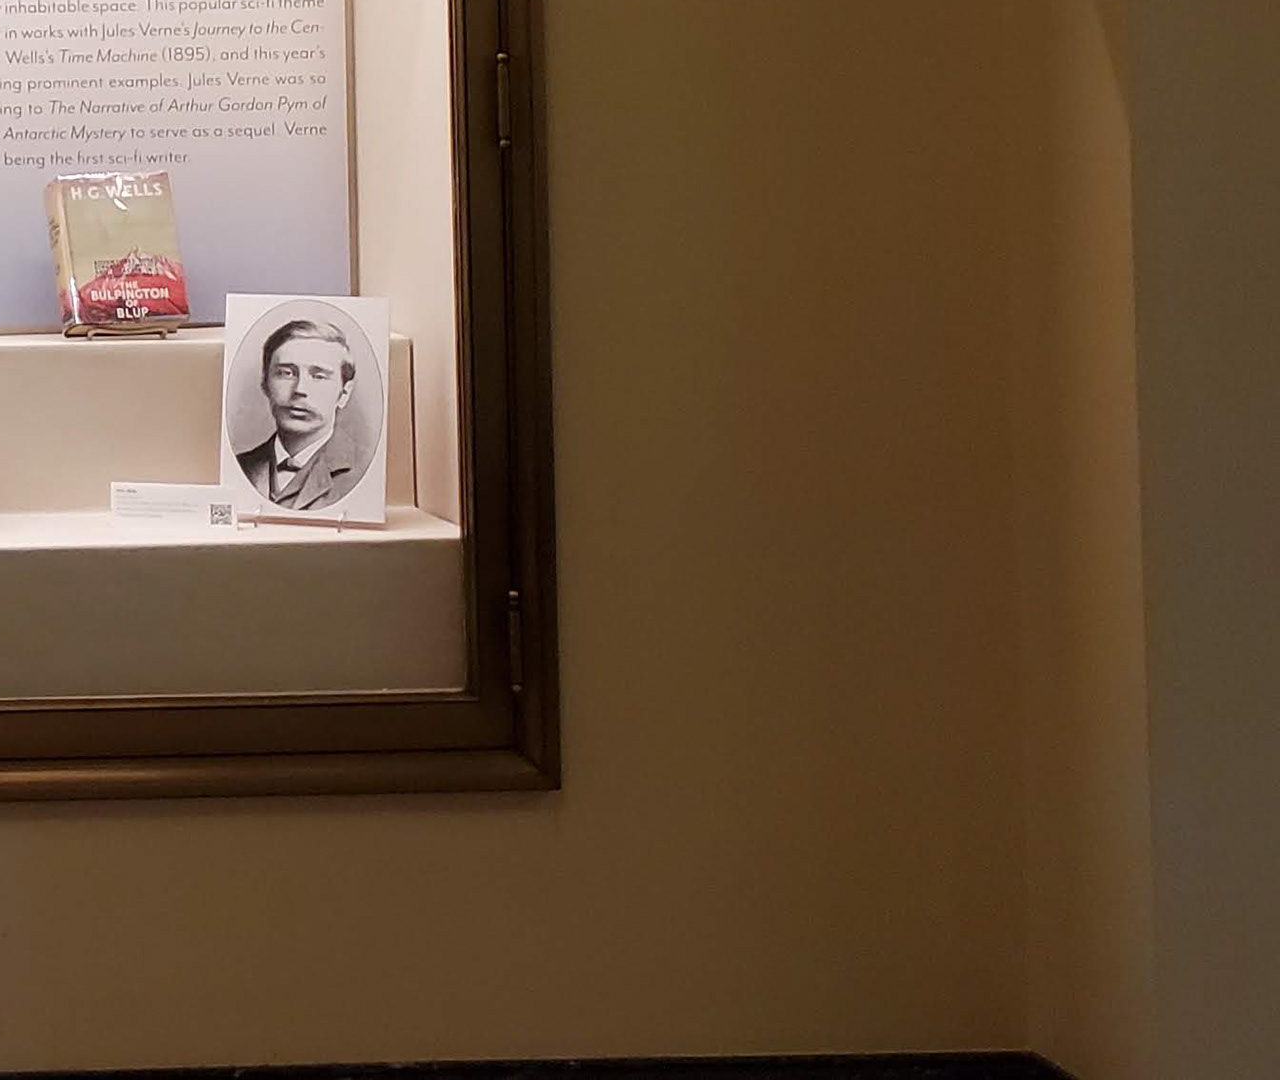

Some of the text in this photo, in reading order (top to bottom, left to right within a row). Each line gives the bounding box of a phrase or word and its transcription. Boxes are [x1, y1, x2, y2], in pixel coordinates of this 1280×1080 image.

[4, 50, 55, 64] Wells's
[57, 49, 95, 63] Time
[95, 48, 159, 63] Machine
[219, 46, 250, 61] and
[253, 45, 281, 60] this
[281, 45, 327, 63] year's
[26, 78, 104, 94] prominent
[184, 72, 223, 89] Jules
[225, 72, 271, 86] Verne
[274, 74, 305, 85] was
[308, 75, 328, 85] so
[105, 182, 163, 199] WELLS
[120, 281, 138, 290] THE
[91, 287, 170, 302] BULPINGTON
[125, 296, 139, 308] OF
[116, 306, 150, 319] BLUP
